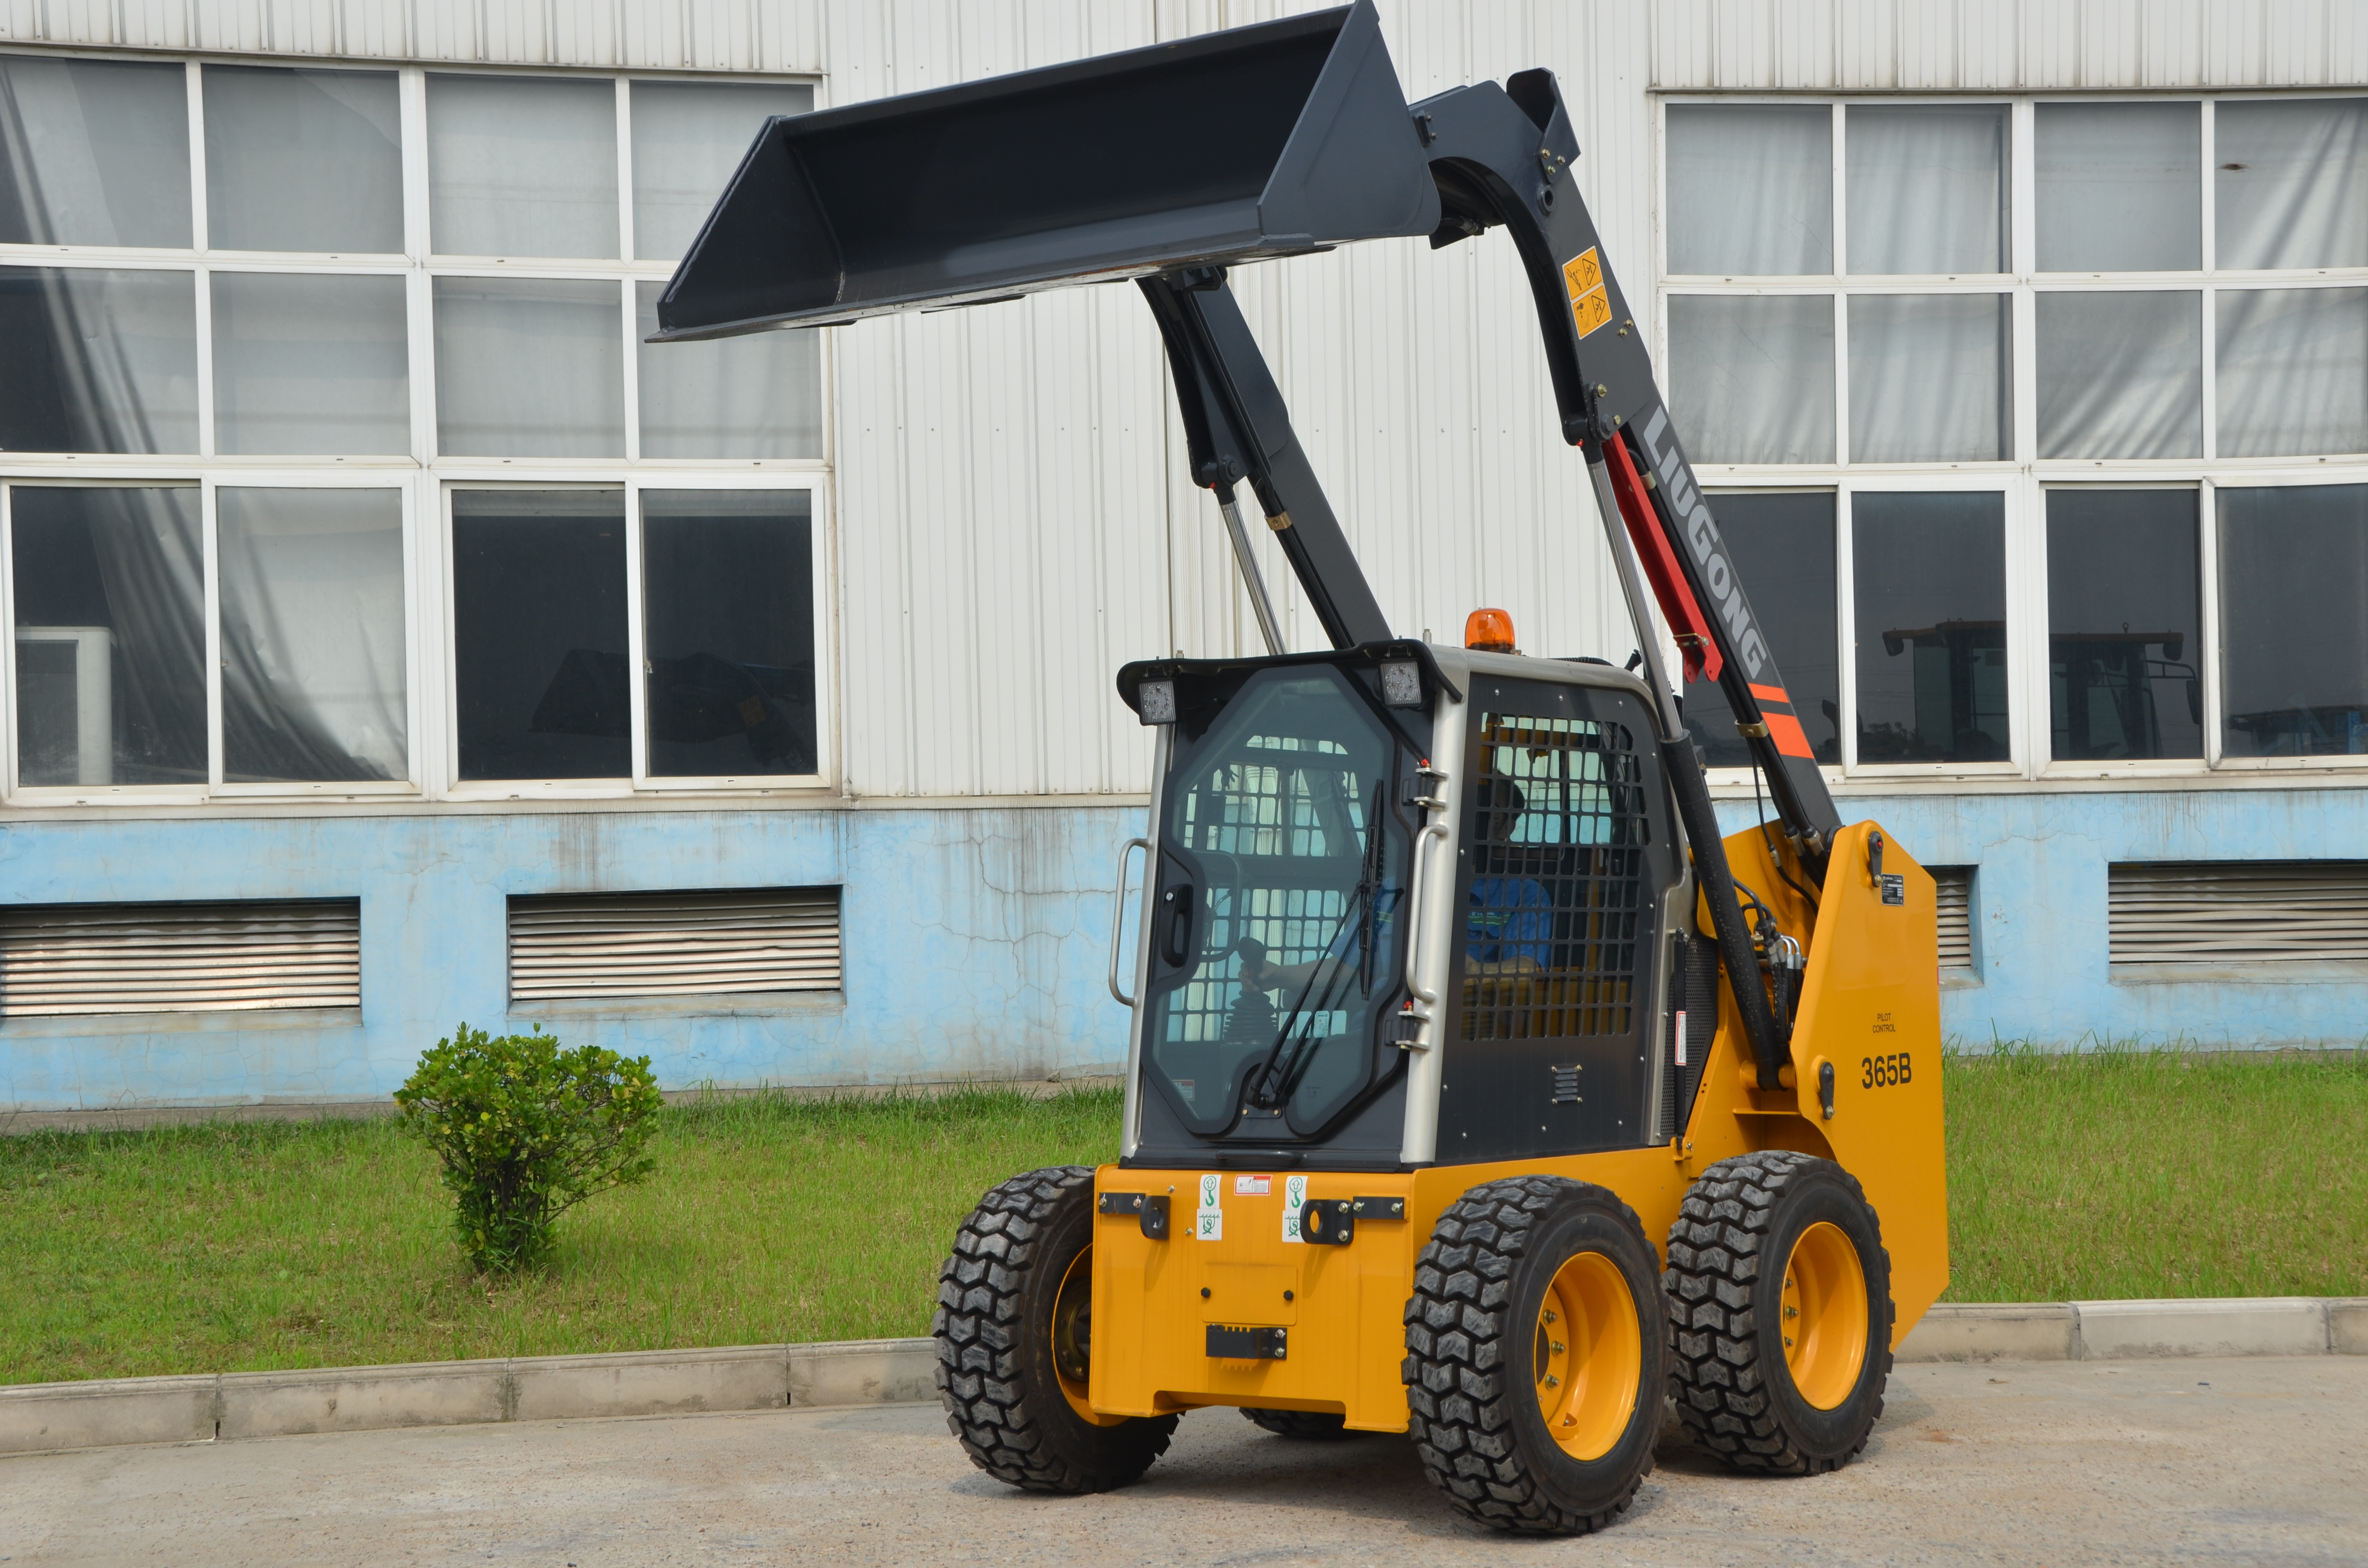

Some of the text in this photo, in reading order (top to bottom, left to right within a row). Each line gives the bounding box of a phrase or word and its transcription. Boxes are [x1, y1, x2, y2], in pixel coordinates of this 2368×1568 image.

[1643, 404, 1767, 679] LIUGONG
[1872, 1024, 1896, 1033] CONTROL
[1877, 1013, 1891, 1022] PILOT
[1861, 1052, 1912, 1090] 365B
